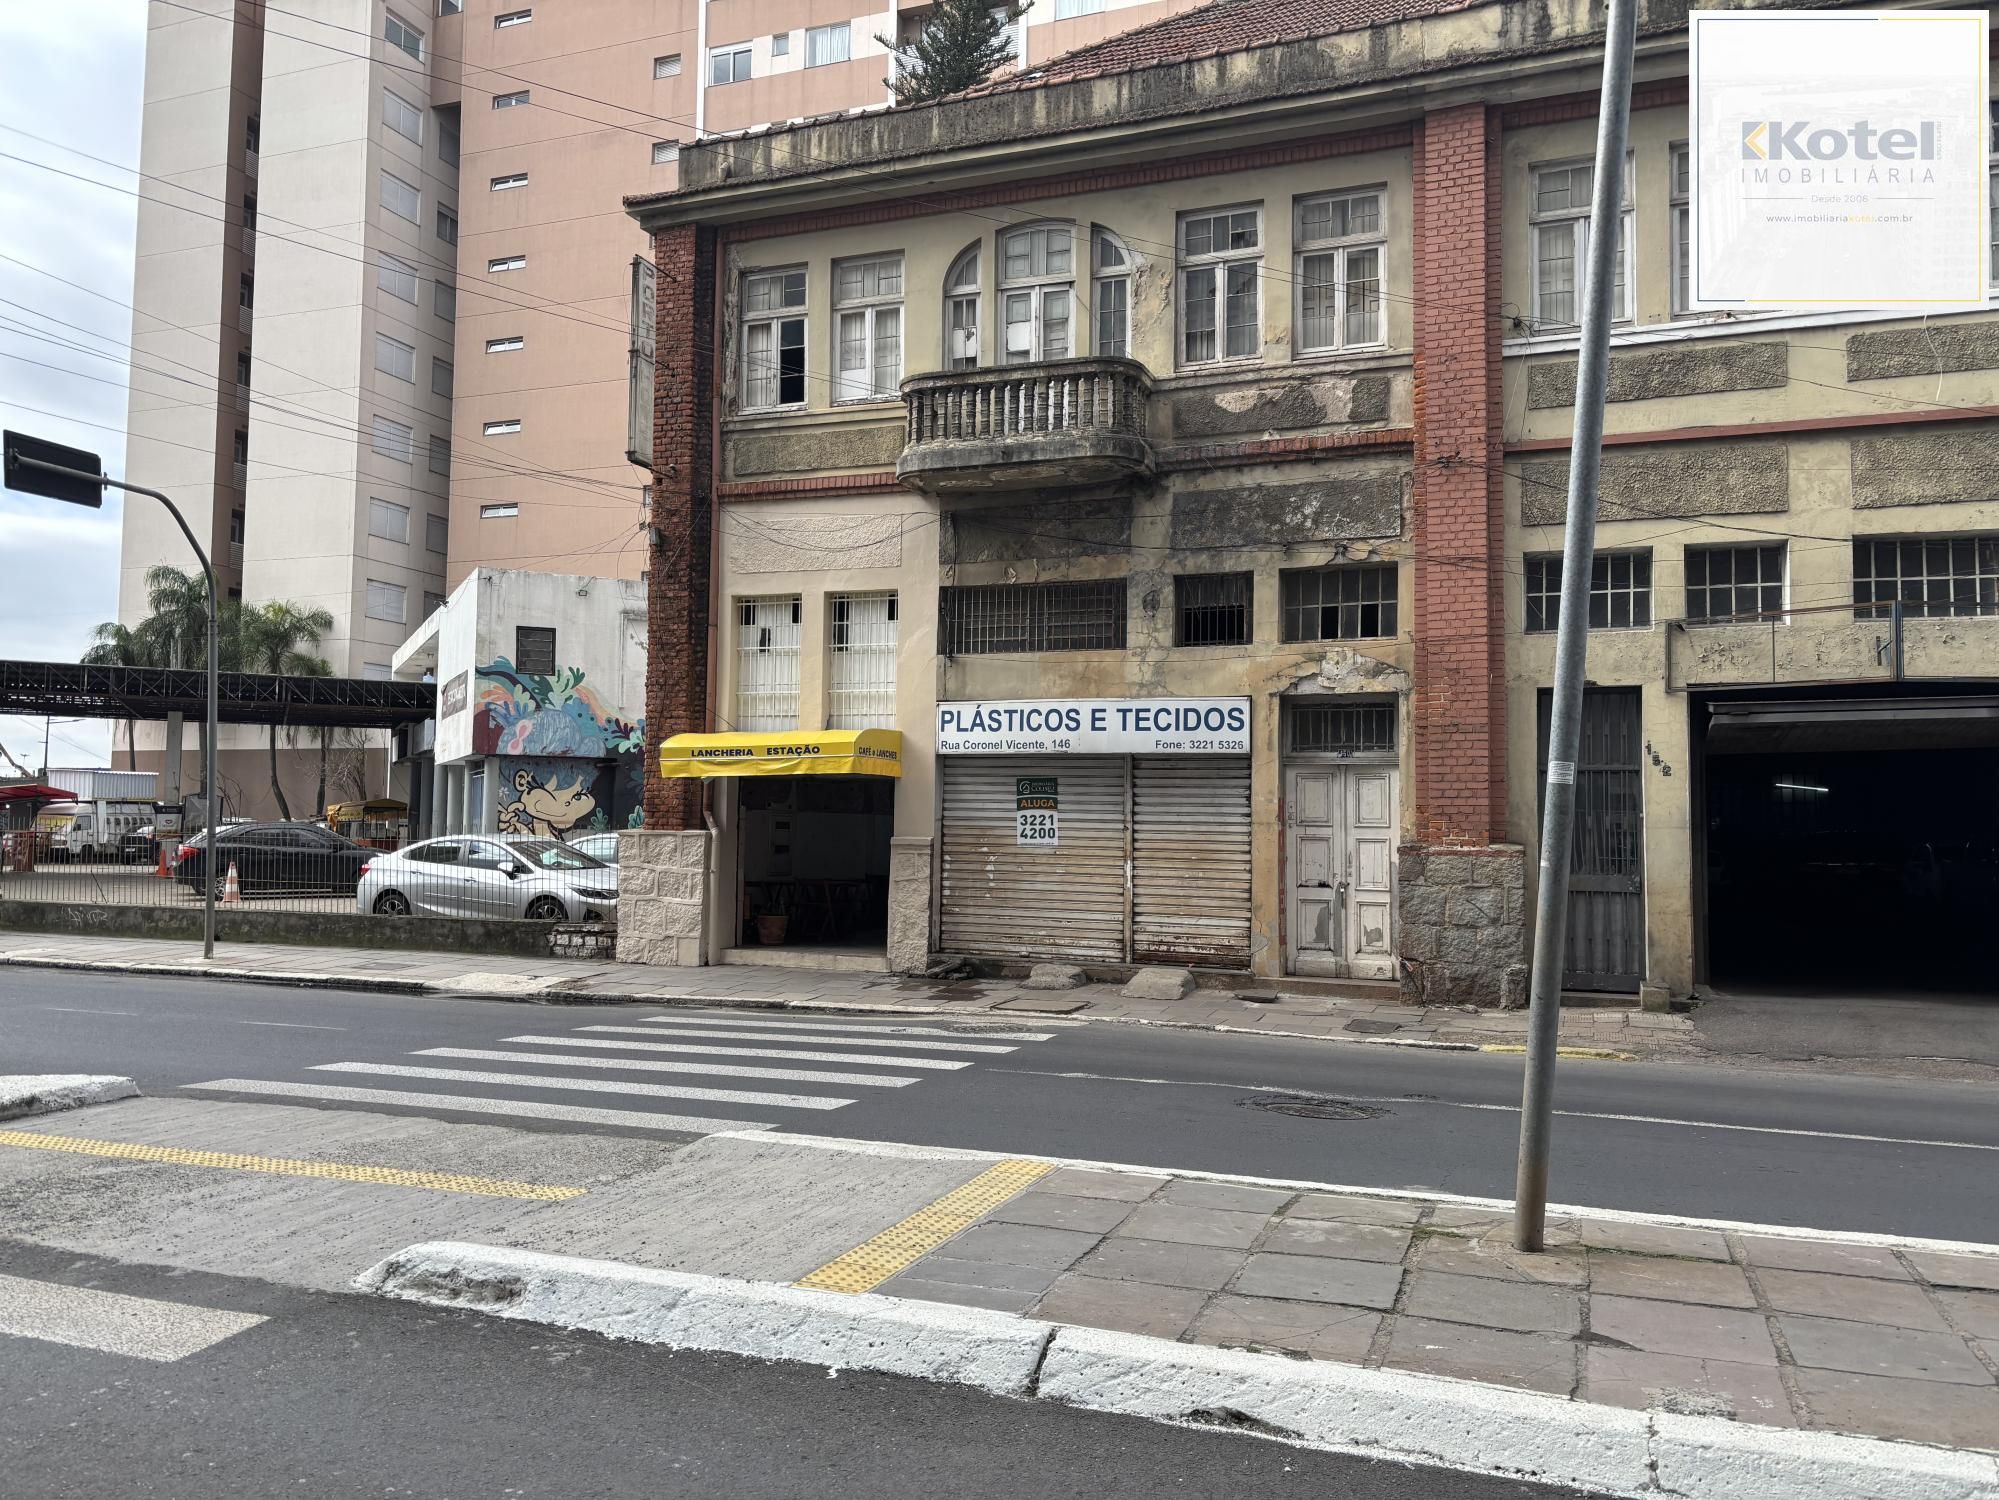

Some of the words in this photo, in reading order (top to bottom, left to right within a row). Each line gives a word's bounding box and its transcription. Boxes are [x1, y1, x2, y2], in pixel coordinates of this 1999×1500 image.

[940, 704, 1081, 732] PLÁSTICOS
[1090, 708, 1107, 731] E
[1116, 707, 1245, 732] TECIDOS
[941, 739, 960, 749] Rua
[963, 739, 1003, 750] Coronel
[1006, 739, 1048, 751] Vicente,
[1051, 739, 1071, 750] 146
[1155, 739, 1185, 750] Fone:
[1189, 739, 1214, 750] 3221
[1218, 739, 1244, 750] 5326
[691, 748, 754, 757] LANCHERIA
[766, 745, 820, 756] ESTAÇÃO
[858, 746, 871, 756] CAFÉ
[876, 748, 897, 760] LANCHES
[1020, 799, 1055, 807] ALUGA
[1020, 814, 1054, 826] 3221
[1020, 827, 1055, 839] 4200
